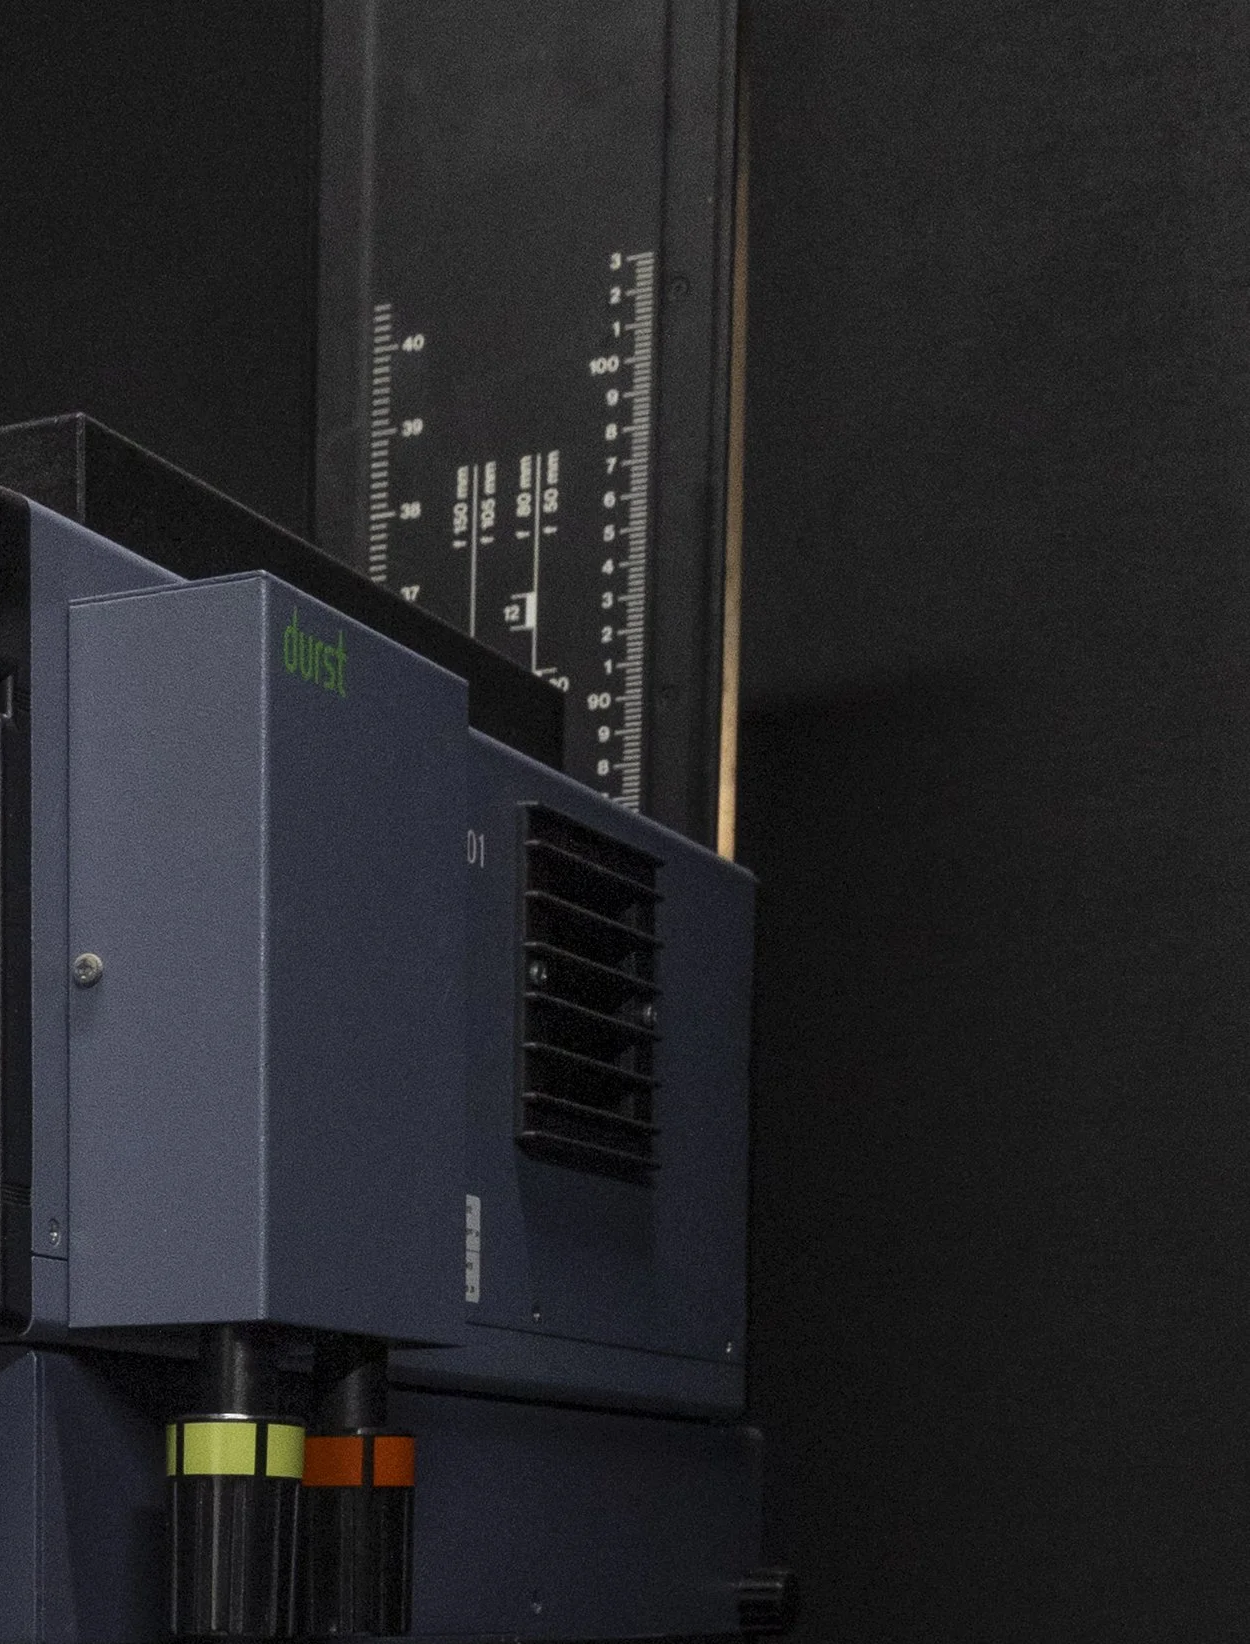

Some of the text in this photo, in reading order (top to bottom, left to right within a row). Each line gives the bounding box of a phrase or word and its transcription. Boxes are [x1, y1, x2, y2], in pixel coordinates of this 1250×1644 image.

[610, 286, 621, 304] 2
[613, 321, 621, 337] 1
[403, 334, 425, 352] 40
[589, 355, 620, 376] 100
[606, 456, 618, 474] 7
[601, 558, 614, 575] 4
[601, 591, 614, 609] 3
[503, 604, 521, 622] 12
[601, 625, 613, 644] 2
[283, 606, 348, 698] durst
[604, 659, 612, 675] 1
[587, 692, 612, 711] 90
